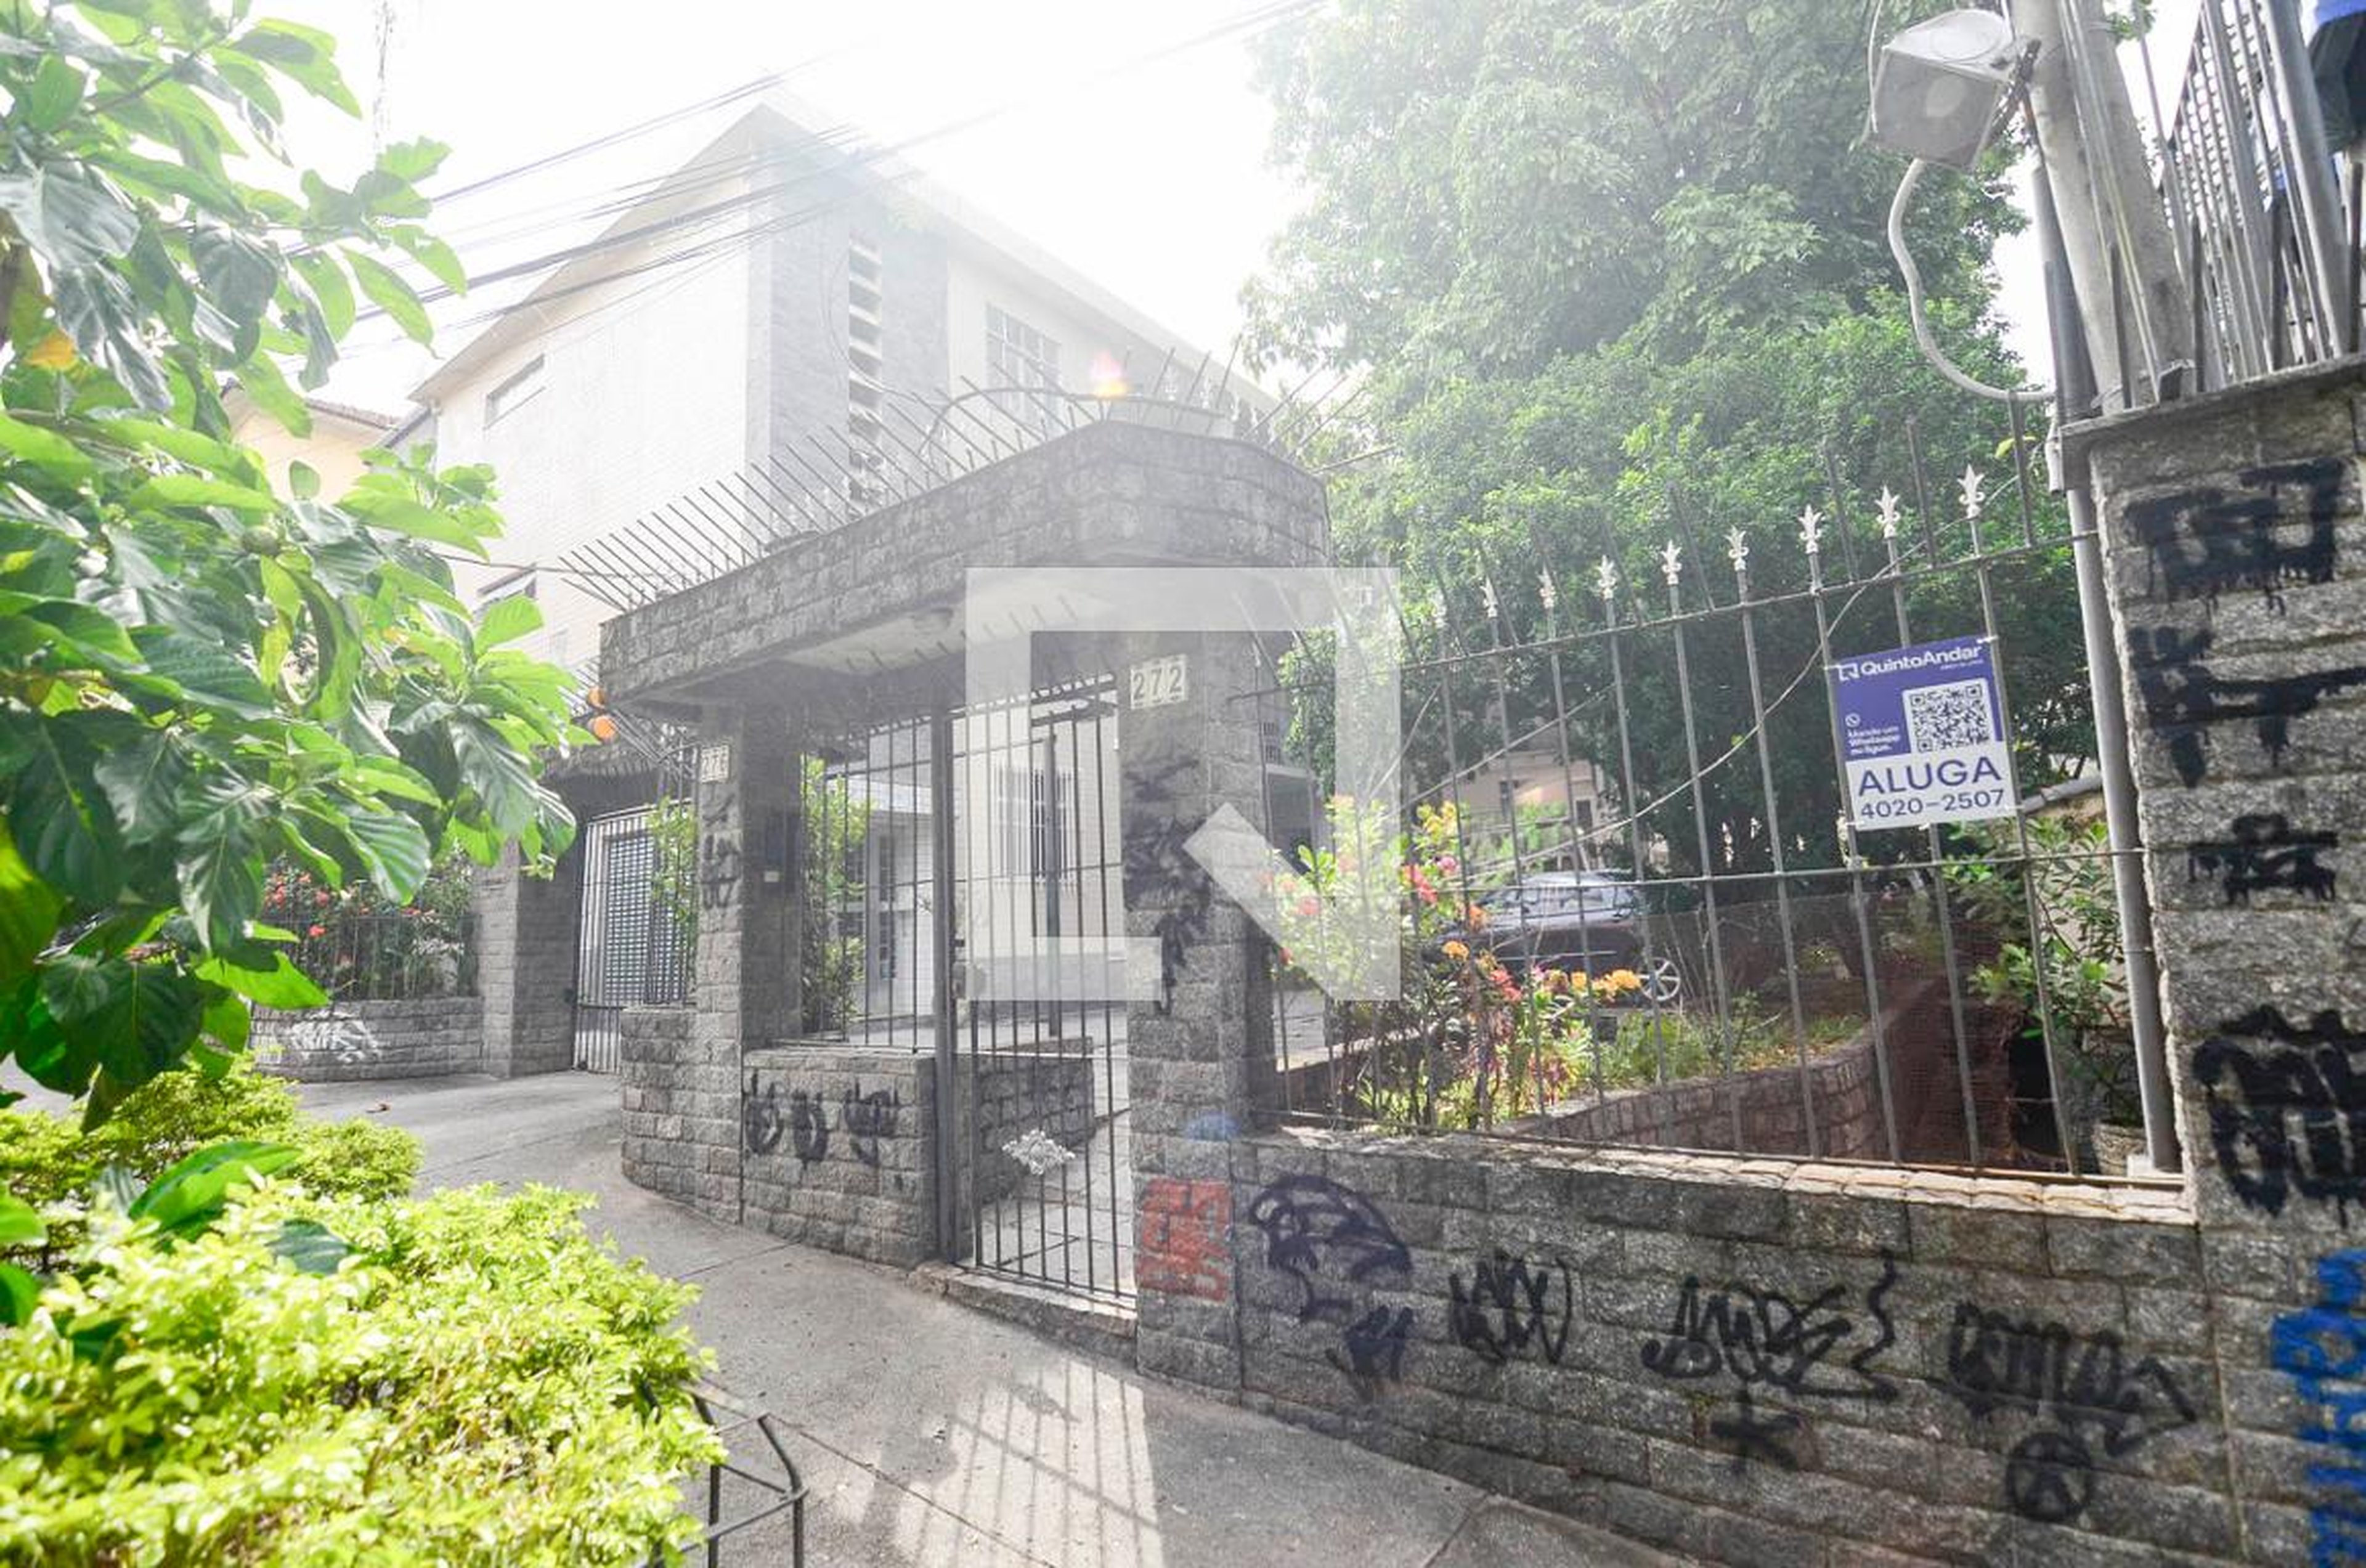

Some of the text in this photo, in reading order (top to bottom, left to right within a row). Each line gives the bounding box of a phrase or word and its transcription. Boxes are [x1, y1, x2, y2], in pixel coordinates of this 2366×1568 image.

[1861, 645, 1982, 676] QuintoAndar
[1132, 665, 1182, 701] 272
[1859, 757, 2002, 797] ALUGA
[1861, 789, 2004, 819] 4020-2507
